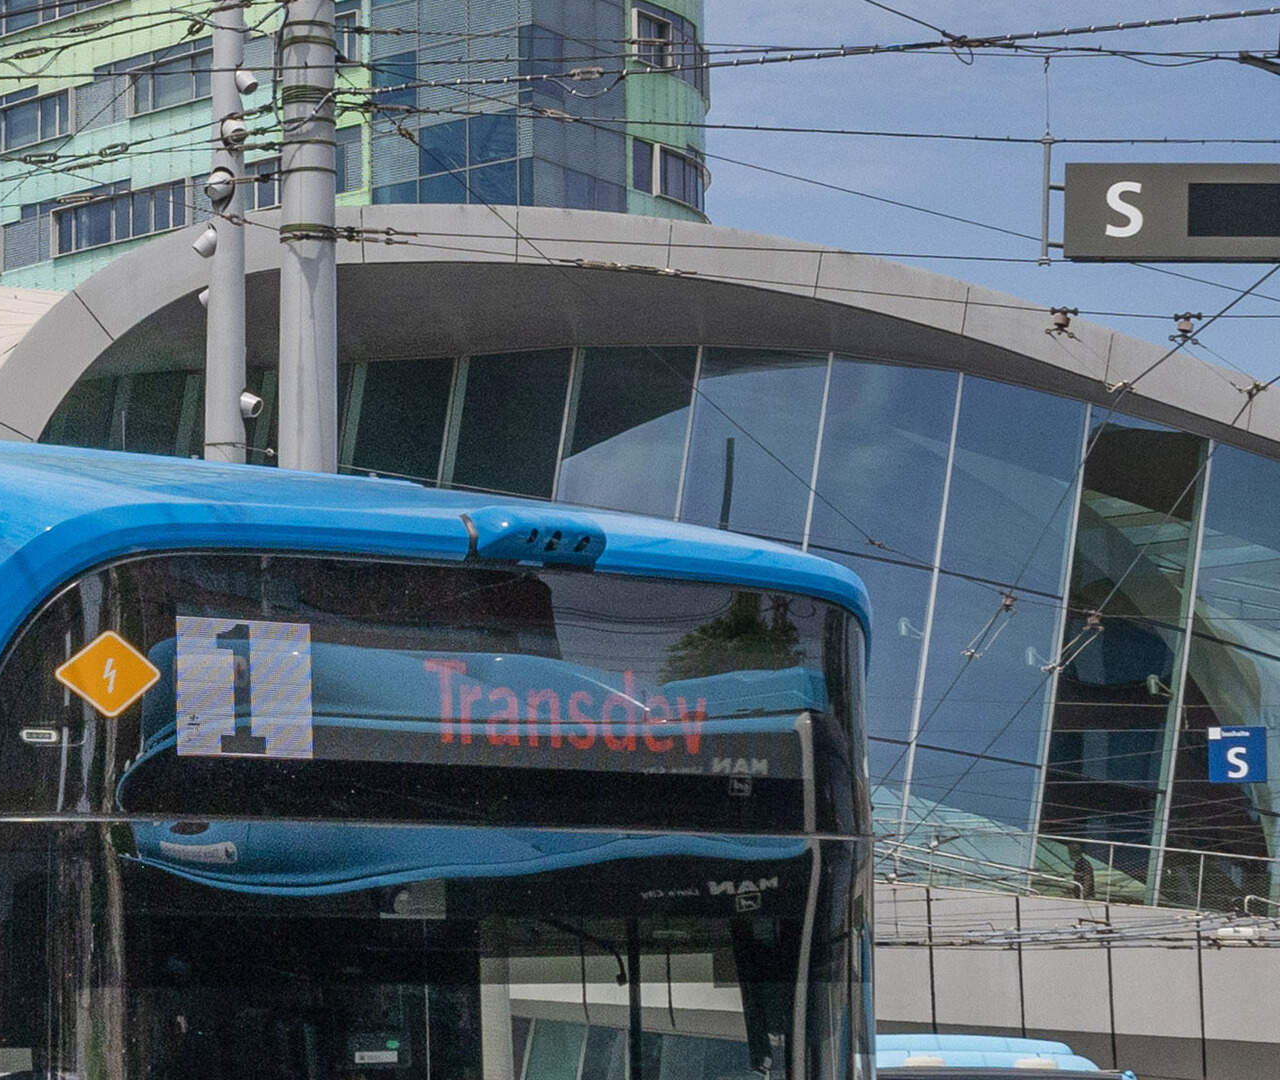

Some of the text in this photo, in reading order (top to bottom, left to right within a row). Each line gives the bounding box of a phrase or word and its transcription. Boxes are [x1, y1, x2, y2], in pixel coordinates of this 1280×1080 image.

[1105, 181, 1143, 237] S
[216, 624, 267, 754] 1
[423, 658, 707, 756] Transdev
[1227, 746, 1249, 778] S
